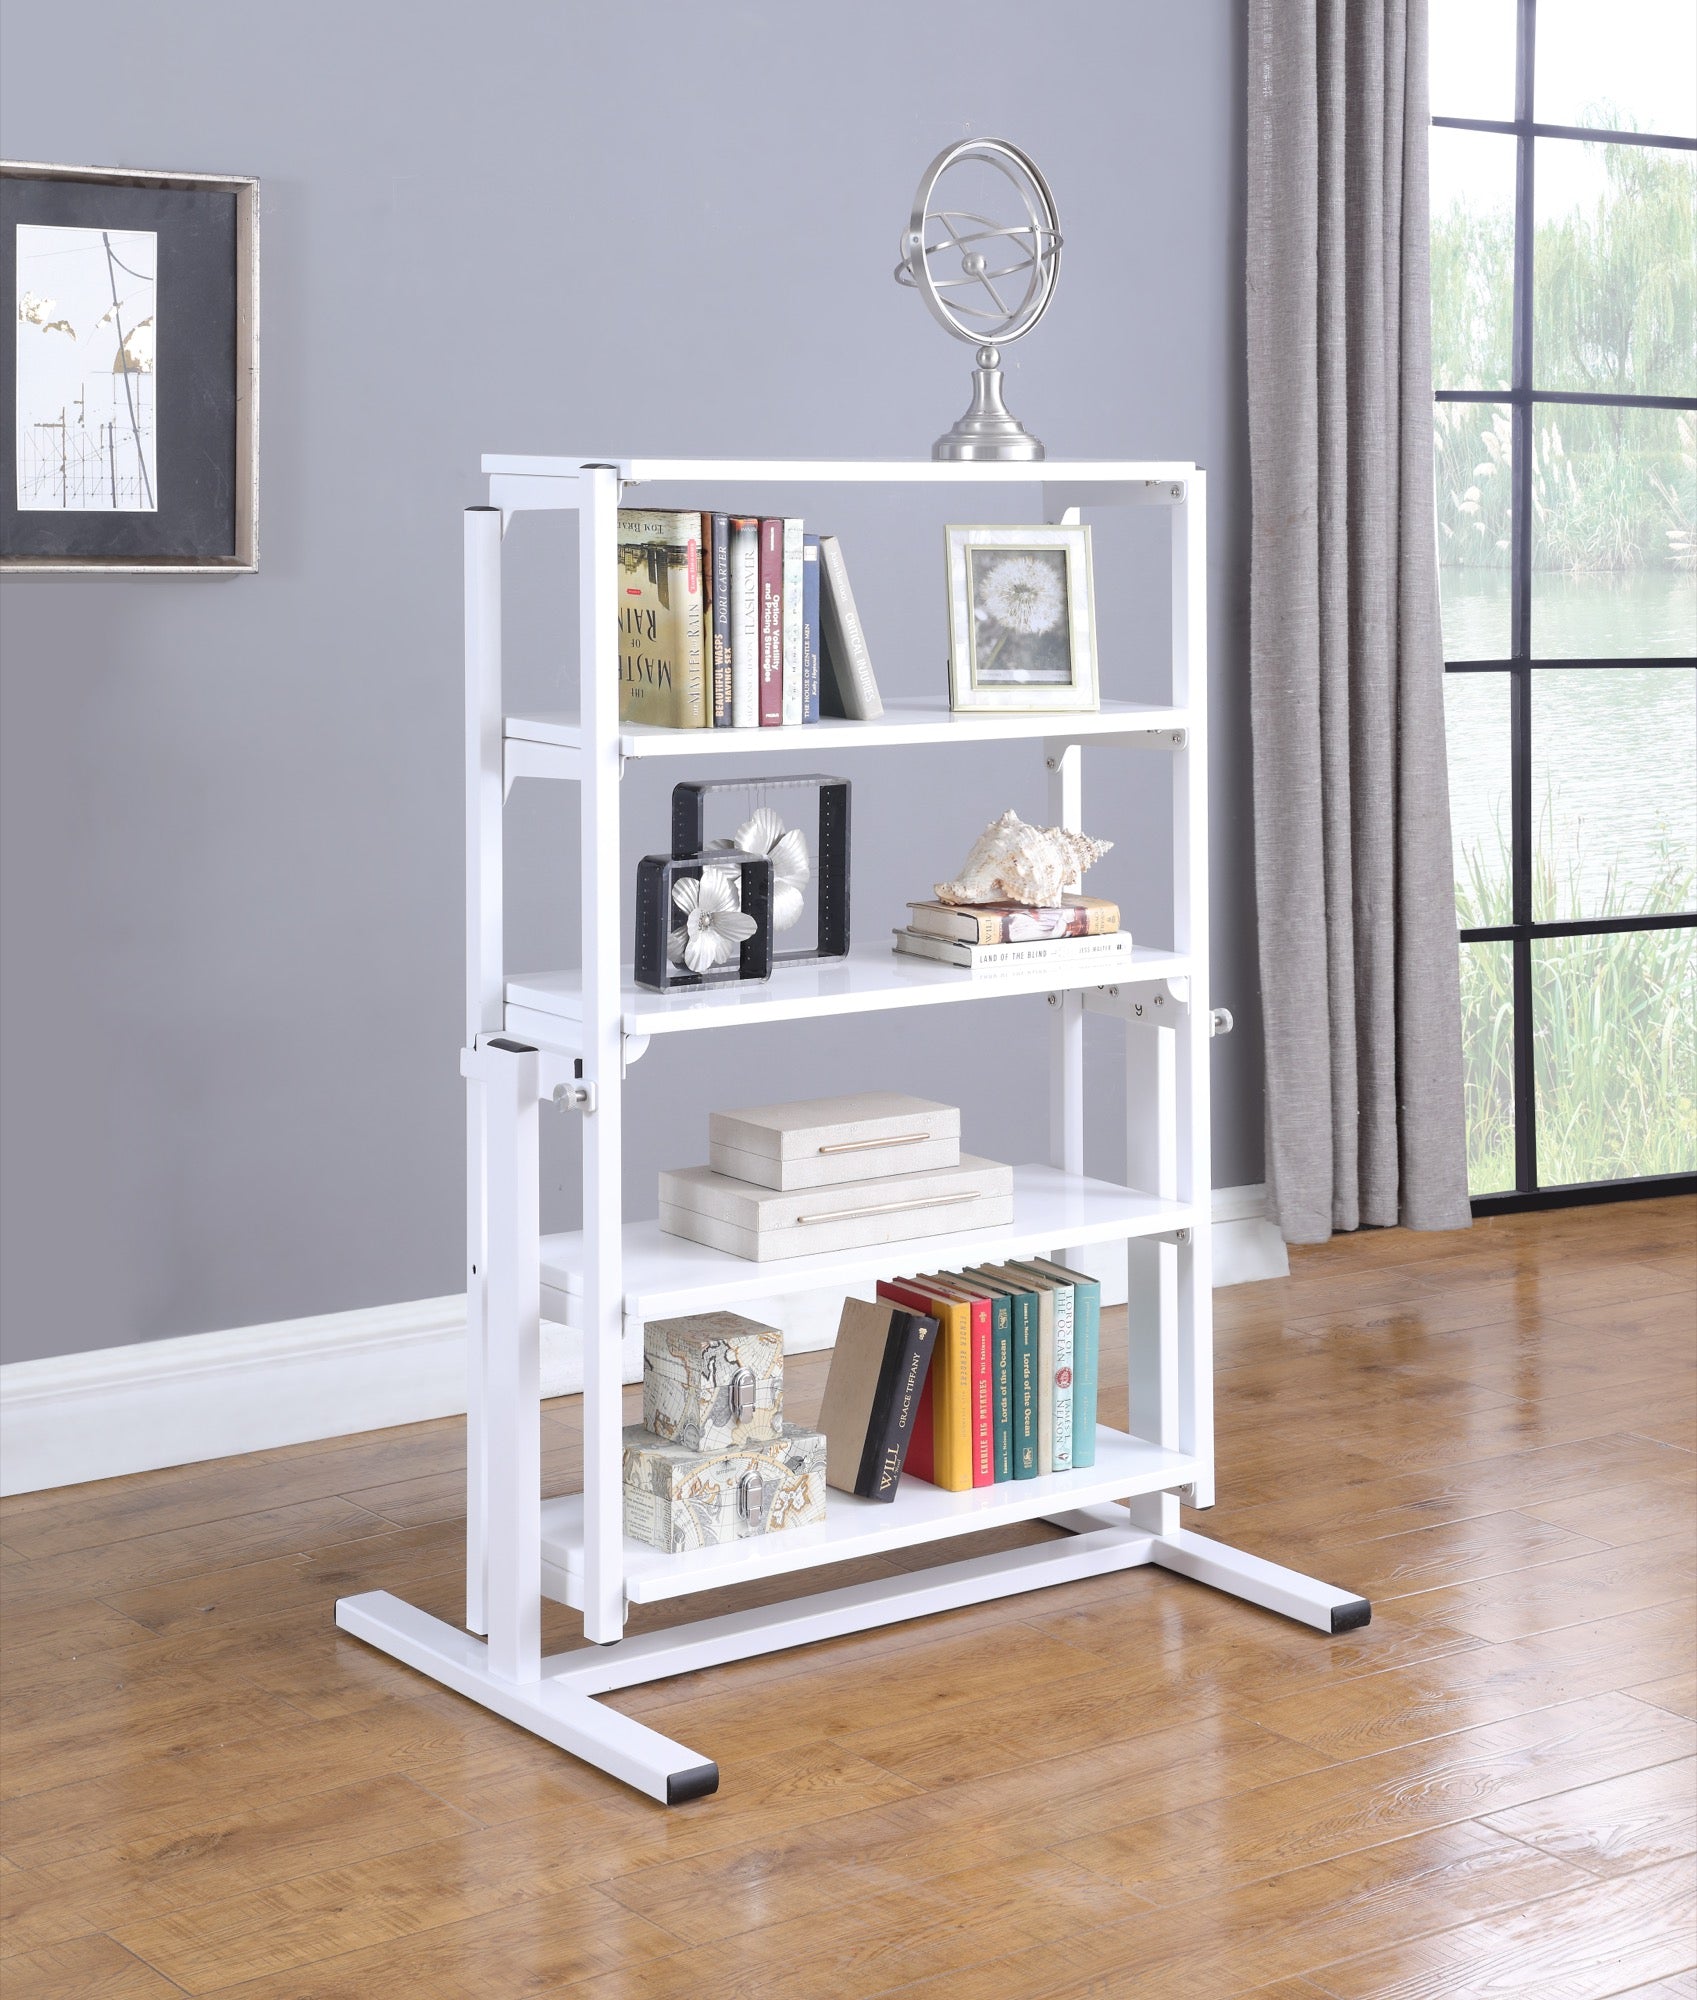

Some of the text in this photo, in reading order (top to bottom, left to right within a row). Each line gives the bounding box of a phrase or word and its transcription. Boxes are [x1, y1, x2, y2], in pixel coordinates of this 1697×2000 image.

[619, 522, 664, 535] TOM BRA
[718, 546, 728, 624] DORI CARTER
[687, 604, 700, 638] RAIN
[763, 602, 772, 634] Pricing
[772, 594, 780, 671] Option Volatility
[631, 638, 642, 648] OF
[763, 636, 772, 683] Strategies
[845, 612, 876, 703] CRITICAL INJURIES
[618, 653, 672, 692] MASTE
[687, 649, 701, 704] MASTER
[714, 633, 724, 717] BEAUTIFUL WASPS
[724, 647, 732, 703] HAVING SEX
[804, 669, 810, 679] OF
[979, 950, 1047, 963] LAND OF THE BLIND
[1057, 1290, 1066, 1362] THE OCEAN
[899, 1352, 921, 1428] GRACE TIFFANY
[1000, 1386, 1007, 1396] of
[1024, 1380, 1031, 1390] of
[980, 1422, 988, 1437] BIG
[1024, 1408, 1032, 1437] Ocean
[1056, 1400, 1064, 1443] NELSON
[1064, 1398, 1072, 1431] JAMES
[880, 1443, 900, 1491] WILL
